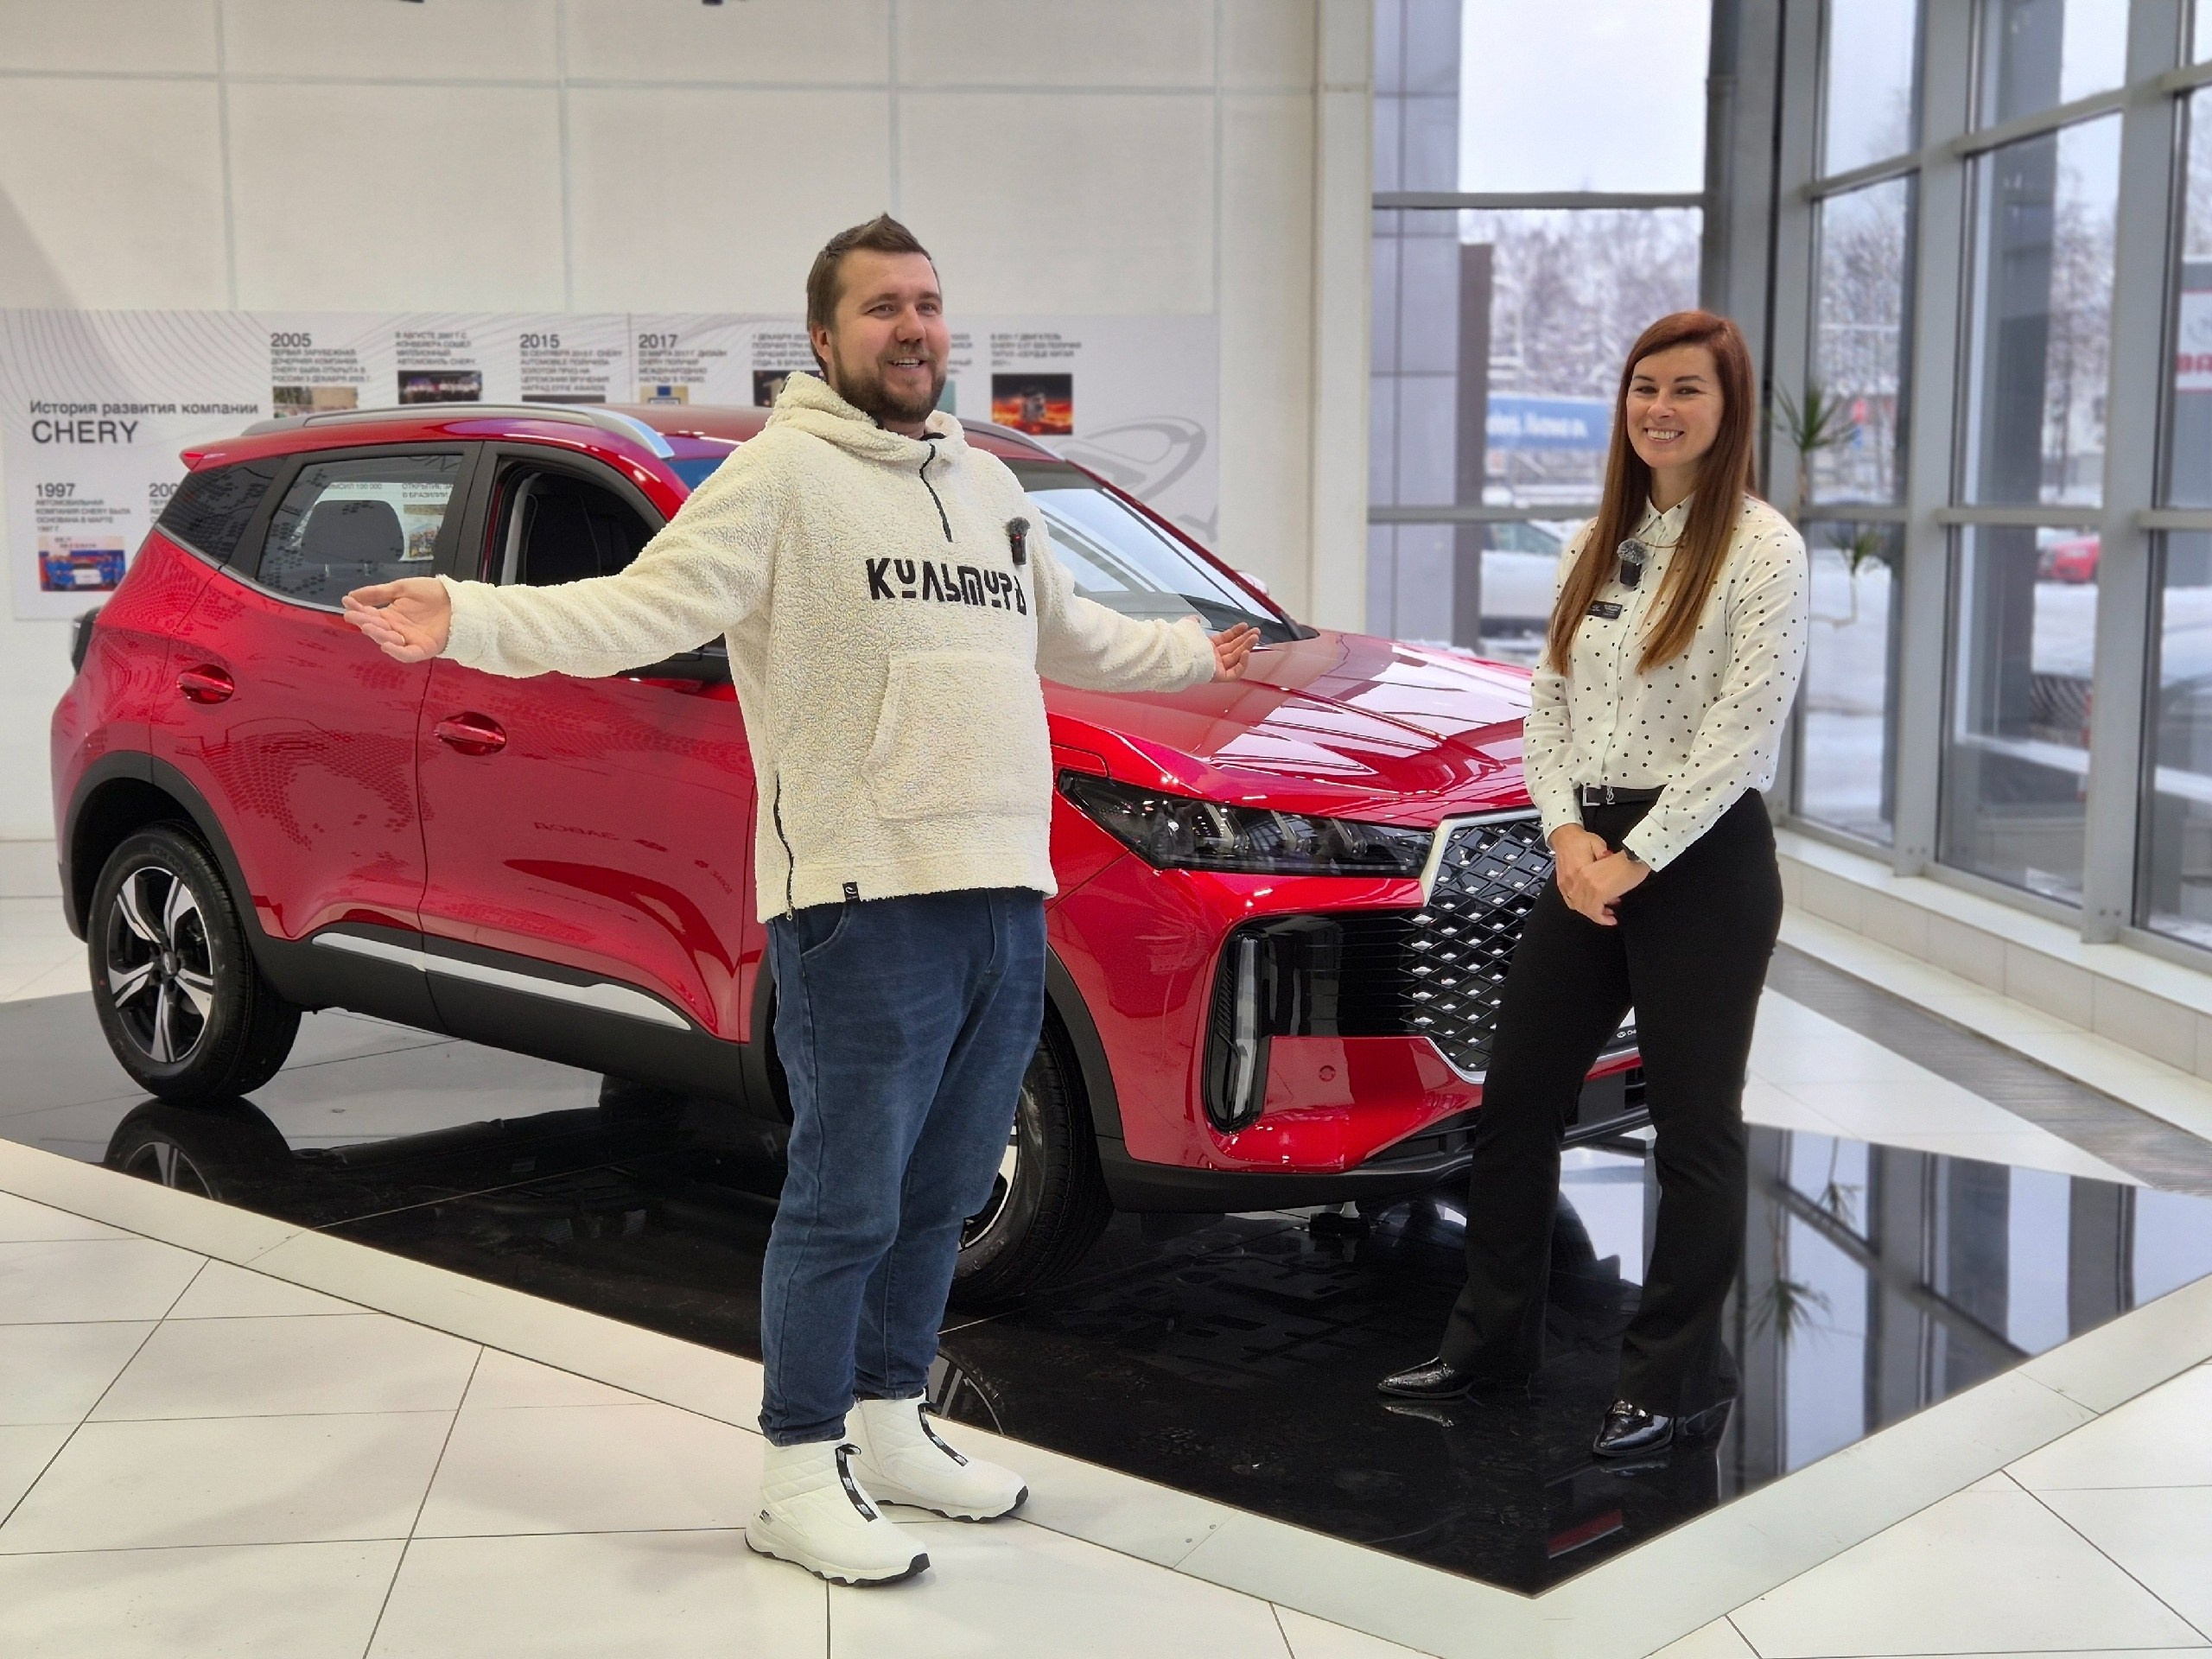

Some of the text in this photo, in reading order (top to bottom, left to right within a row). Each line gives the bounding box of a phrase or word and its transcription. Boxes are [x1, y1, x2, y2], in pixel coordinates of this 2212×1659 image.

[270, 333, 311, 346] 2005
[520, 334, 560, 348] 2015
[639, 334, 678, 348] 2017
[29, 400, 258, 416] История развития компании
[31, 420, 138, 443] CHERY
[36, 483, 75, 497] 1997
[149, 483, 177, 497] 200
